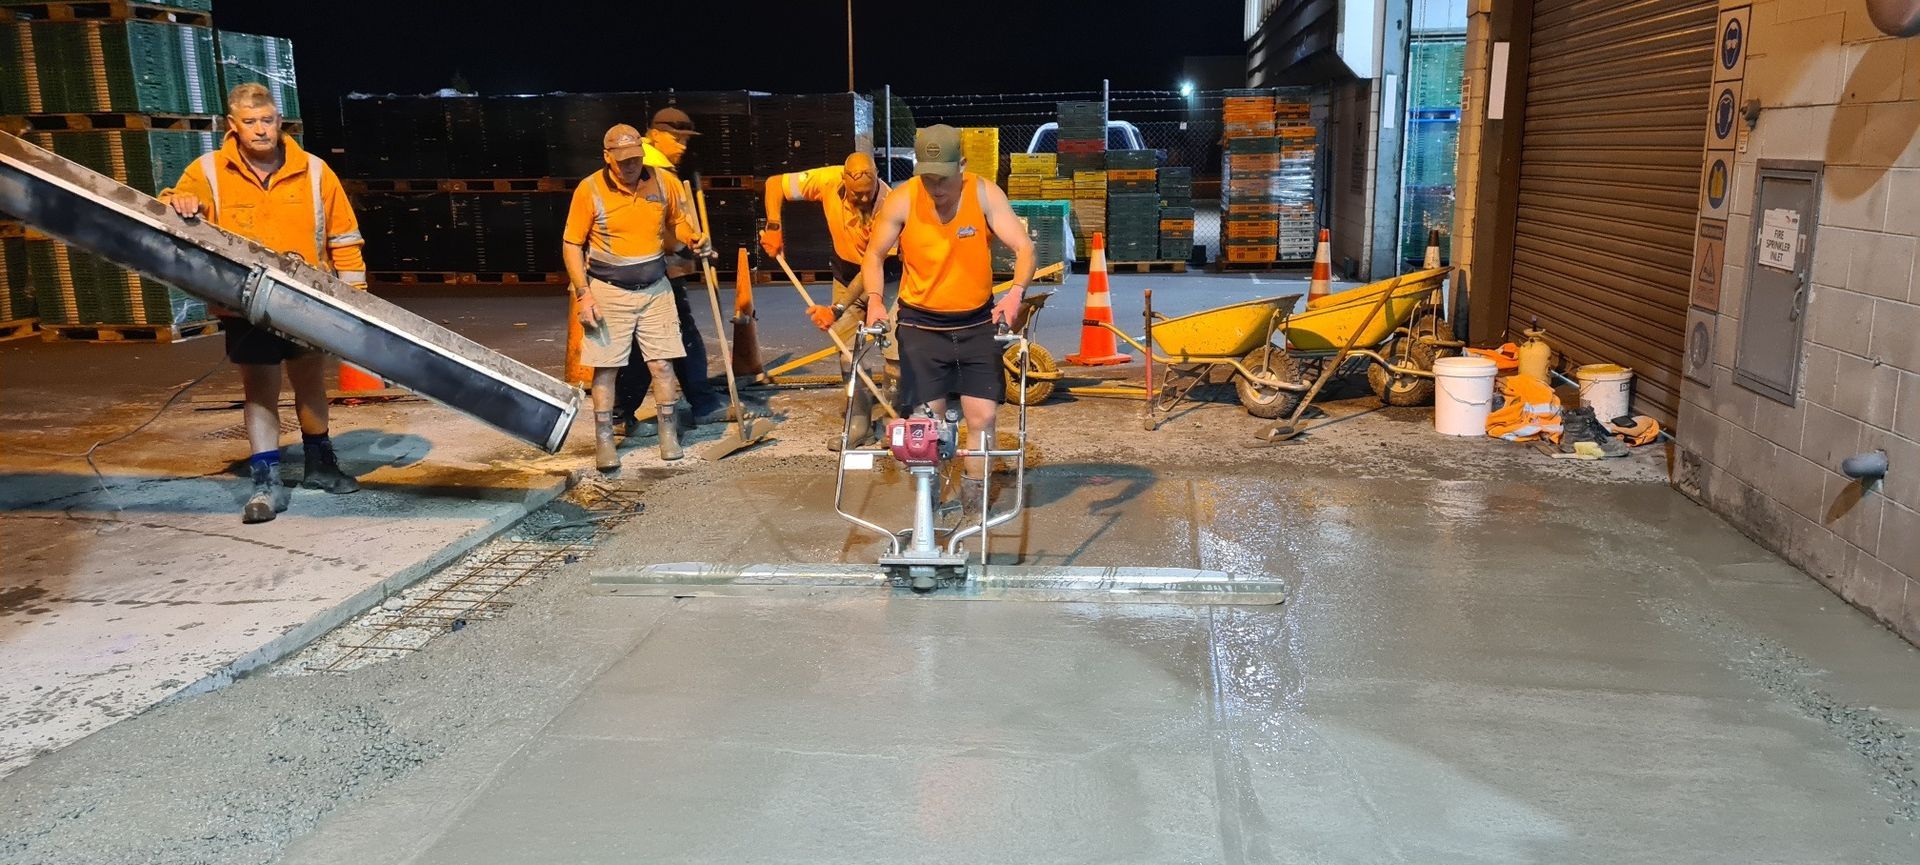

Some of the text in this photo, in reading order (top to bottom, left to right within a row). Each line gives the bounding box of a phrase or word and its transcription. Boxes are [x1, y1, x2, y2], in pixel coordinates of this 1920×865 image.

[1774, 229, 1784, 240] FIRE
[1766, 239, 1791, 252] SPRINKLER
[1770, 251, 1784, 262] INLET
